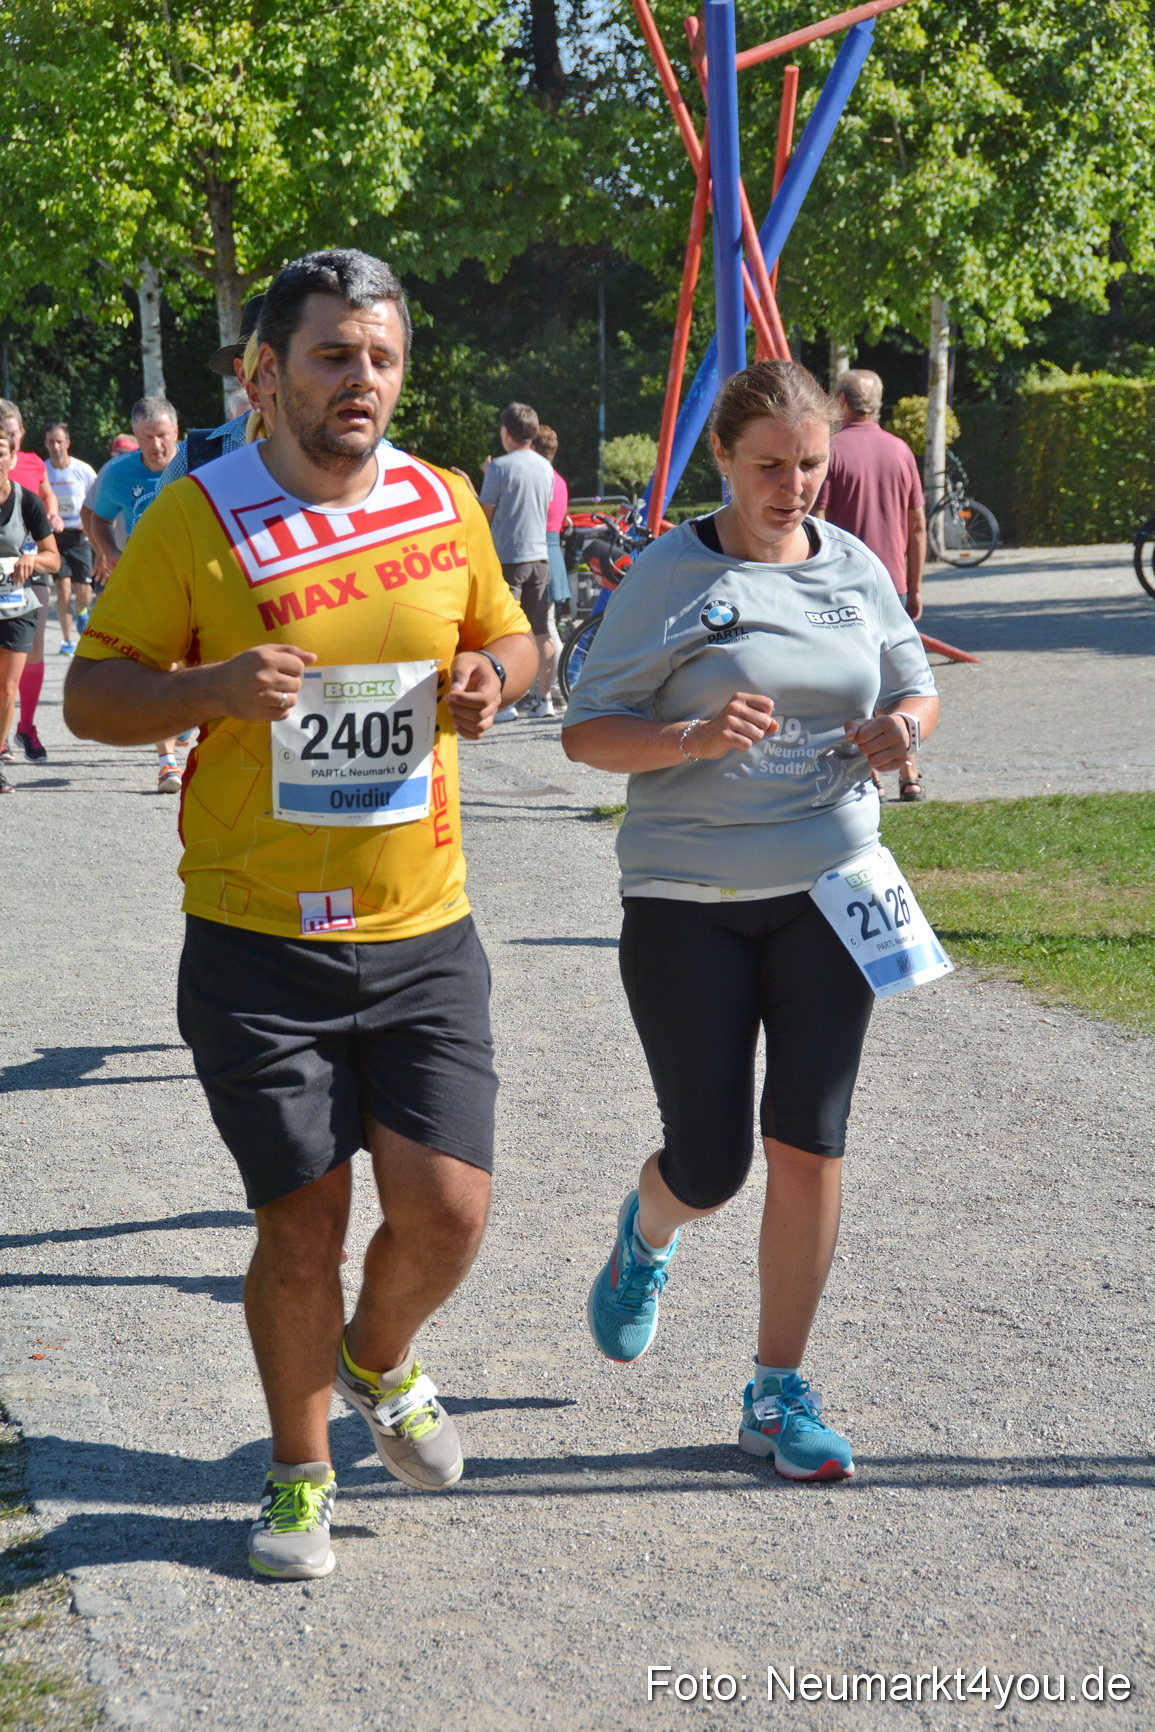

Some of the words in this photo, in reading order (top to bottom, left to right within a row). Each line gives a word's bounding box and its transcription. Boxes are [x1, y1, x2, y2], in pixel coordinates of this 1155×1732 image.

[257, 572, 368, 632] MAX
[374, 540, 468, 591] BÖGL
[707, 626, 749, 644] PARTL
[324, 680, 396, 698] BOCK
[300, 709, 414, 760] 2405
[311, 768, 347, 778] PARTL
[350, 766, 395, 777] Neumarkt
[330, 788, 391, 809] Ovidiu
[846, 885, 911, 941] 2126
